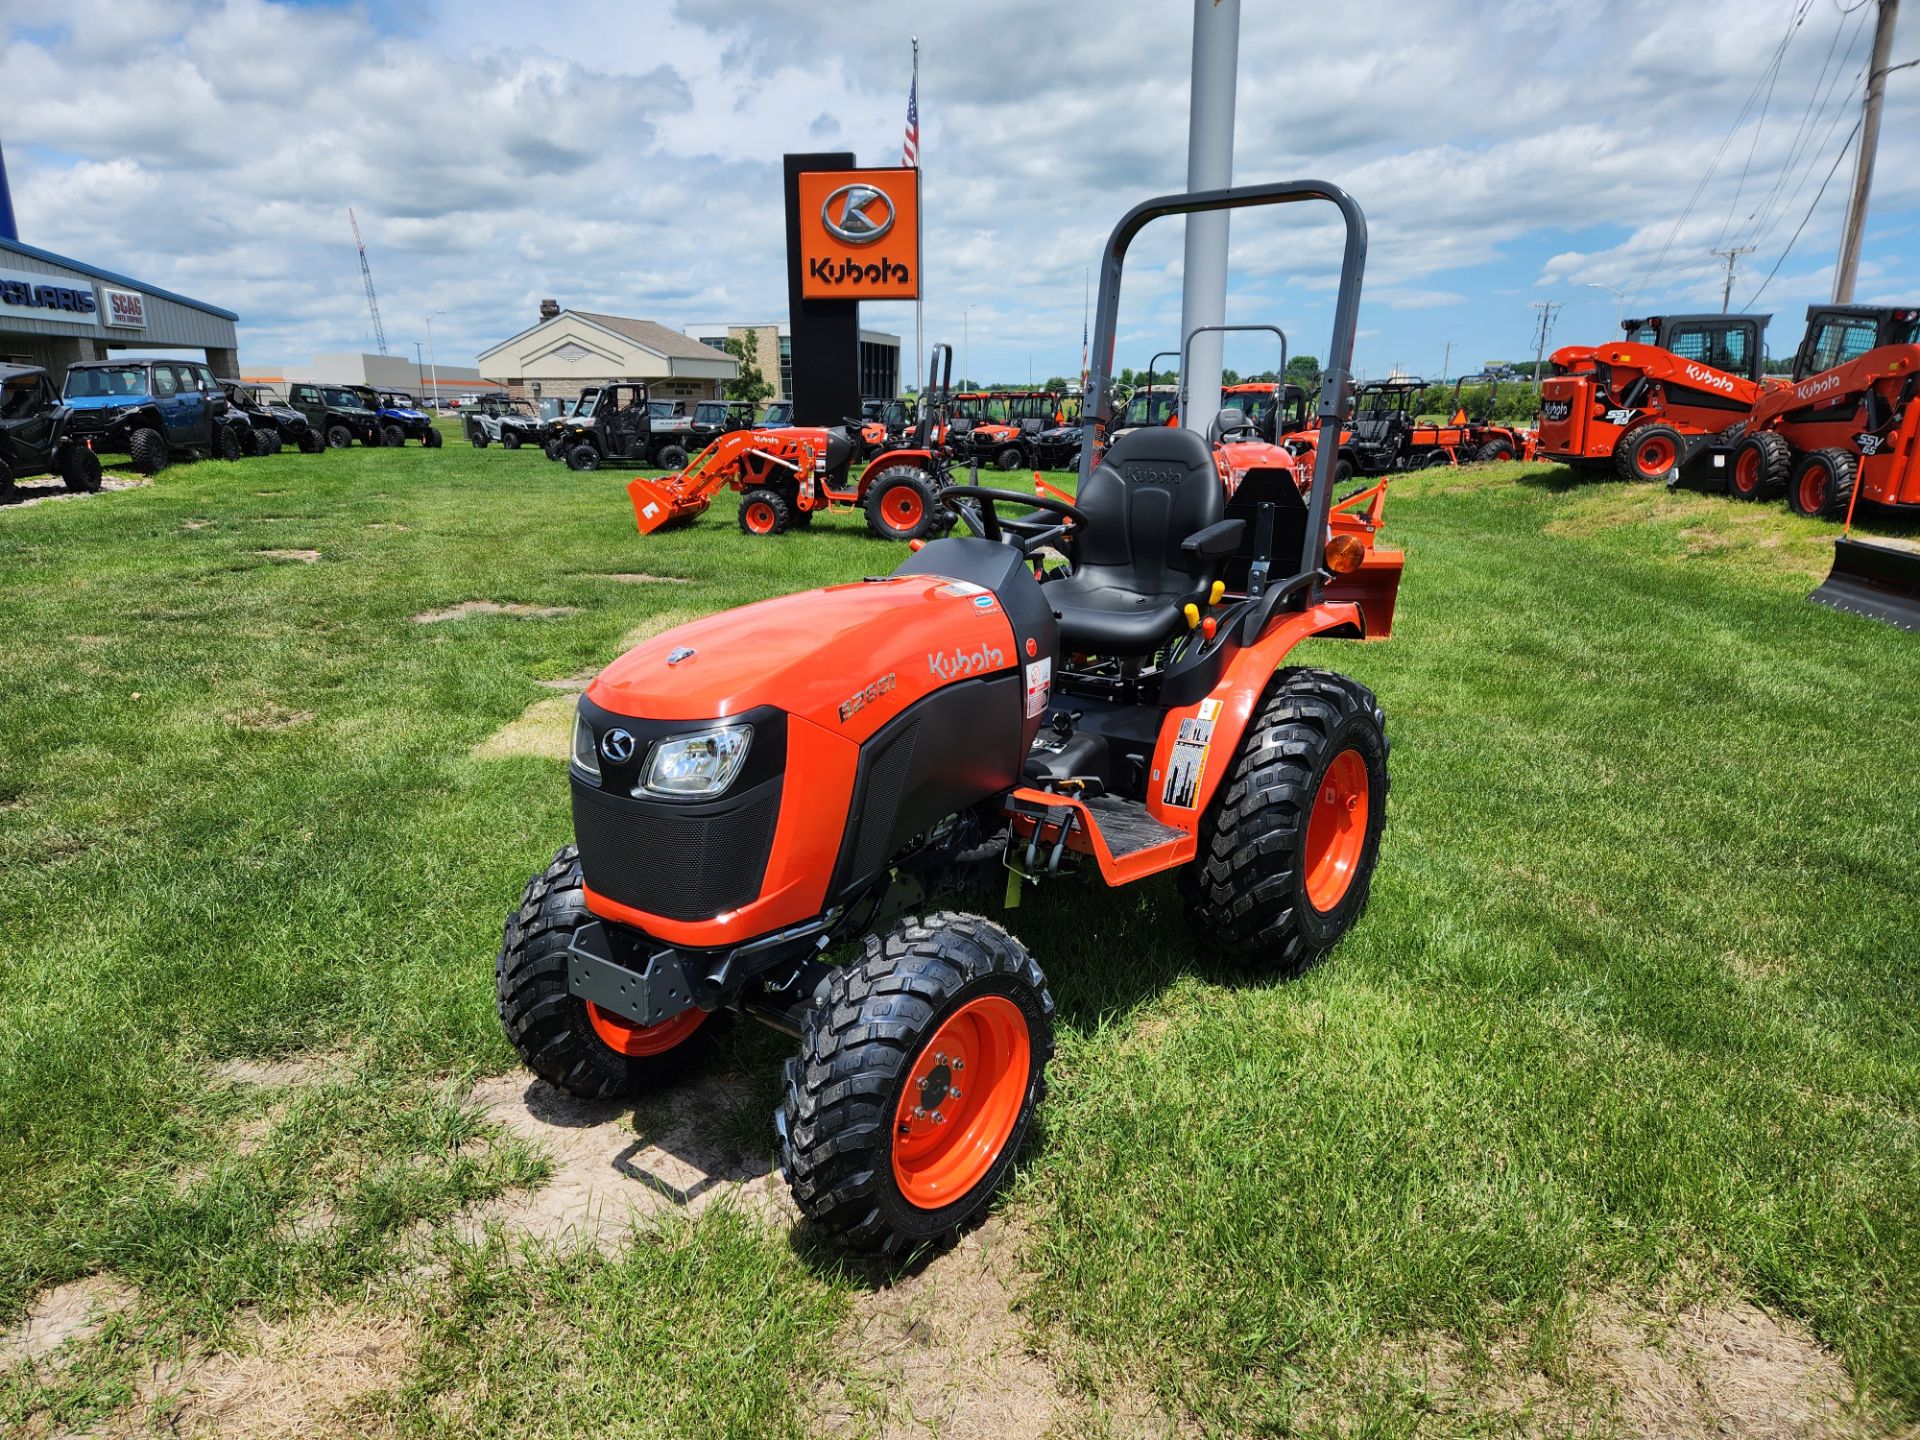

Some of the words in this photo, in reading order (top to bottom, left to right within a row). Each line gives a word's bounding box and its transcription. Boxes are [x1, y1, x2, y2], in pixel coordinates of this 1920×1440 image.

[810, 257, 909, 284] Kubota
[111, 293, 142, 316] SCAG
[1686, 364, 1734, 393] Kubota
[1797, 374, 1840, 399] Kubota
[1545, 402, 1568, 415] Kubota
[1605, 409, 1636, 419] SSV
[753, 434, 779, 444] Kubota
[1858, 433, 1885, 447] SSV
[1125, 467, 1182, 484] Kubota
[928, 643, 1004, 680] Kubota
